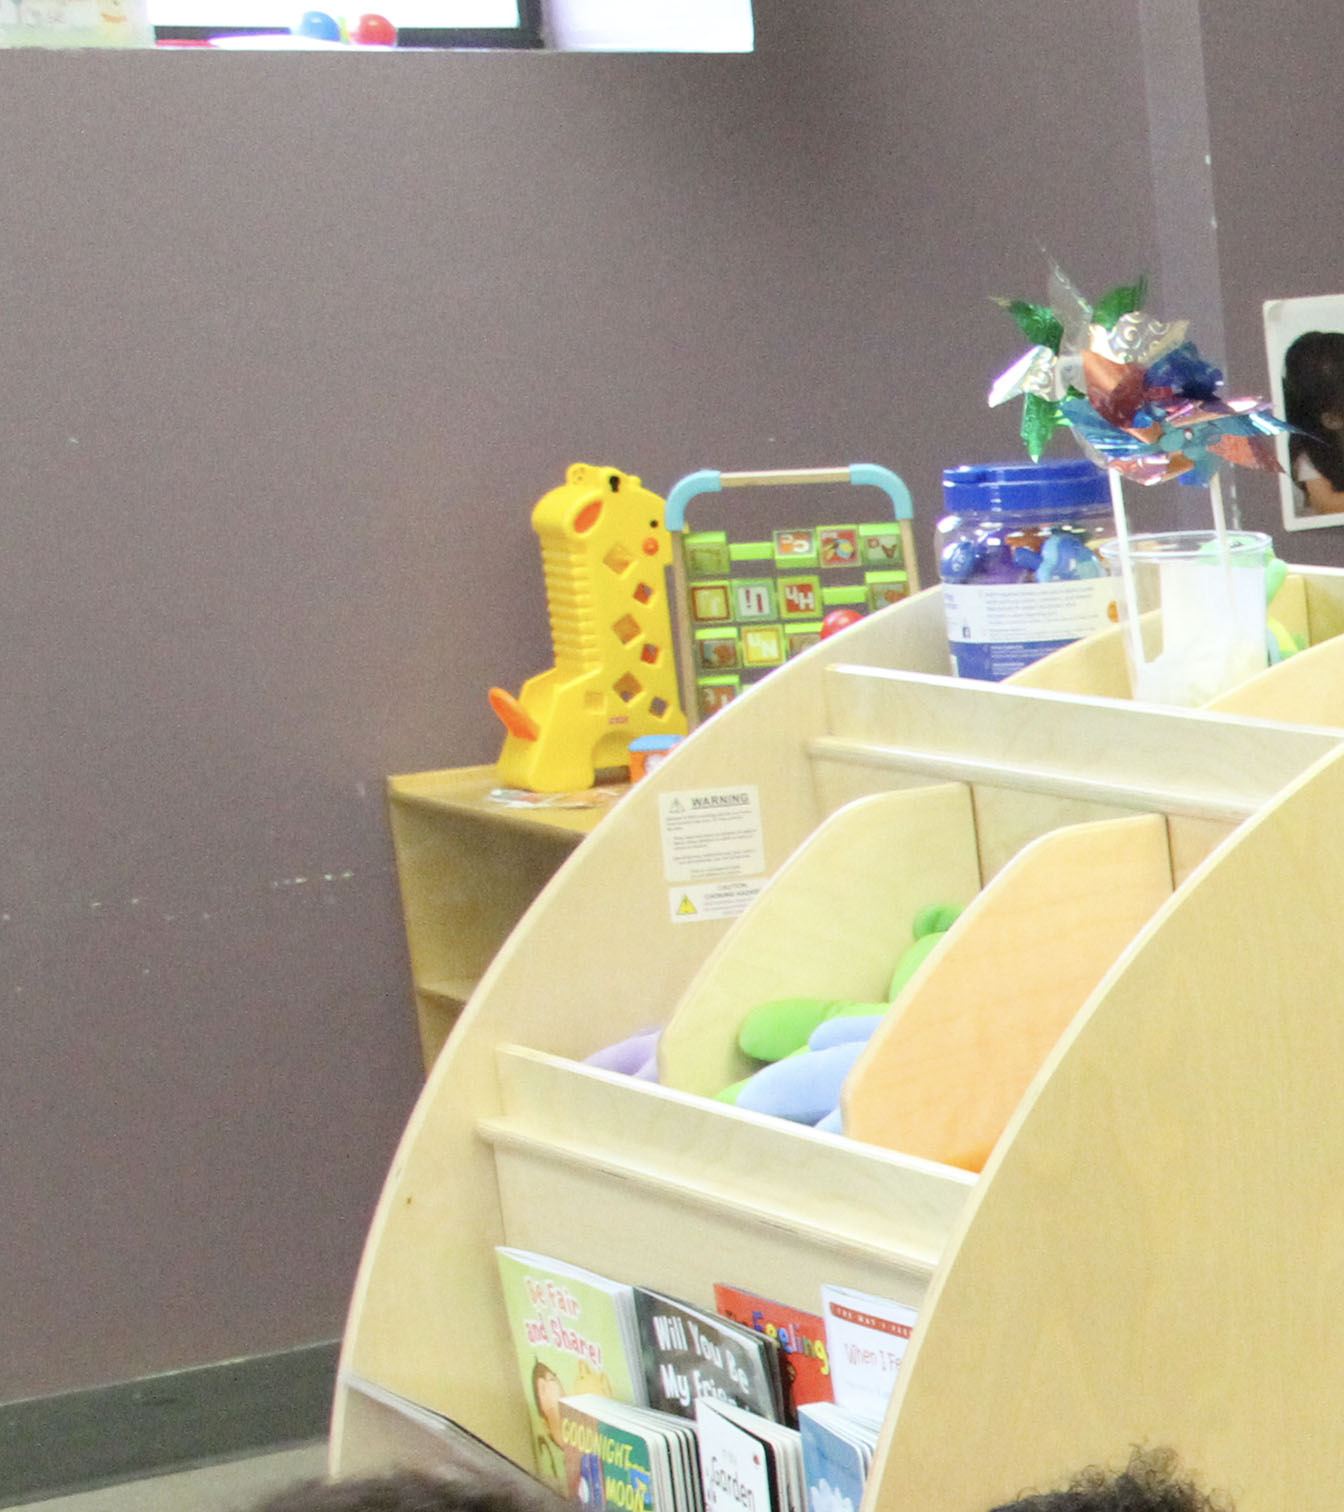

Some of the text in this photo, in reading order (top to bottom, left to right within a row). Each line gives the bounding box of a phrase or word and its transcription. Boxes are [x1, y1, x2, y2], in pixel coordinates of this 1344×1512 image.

[690, 792, 750, 809] WARNING
[523, 1277, 579, 1317] Be Fair
[523, 1311, 604, 1372] and Share!
[653, 1315, 749, 1395] Will You Be
[659, 1363, 691, 1407] My
[562, 1417, 633, 1471] GOODNIGHT
